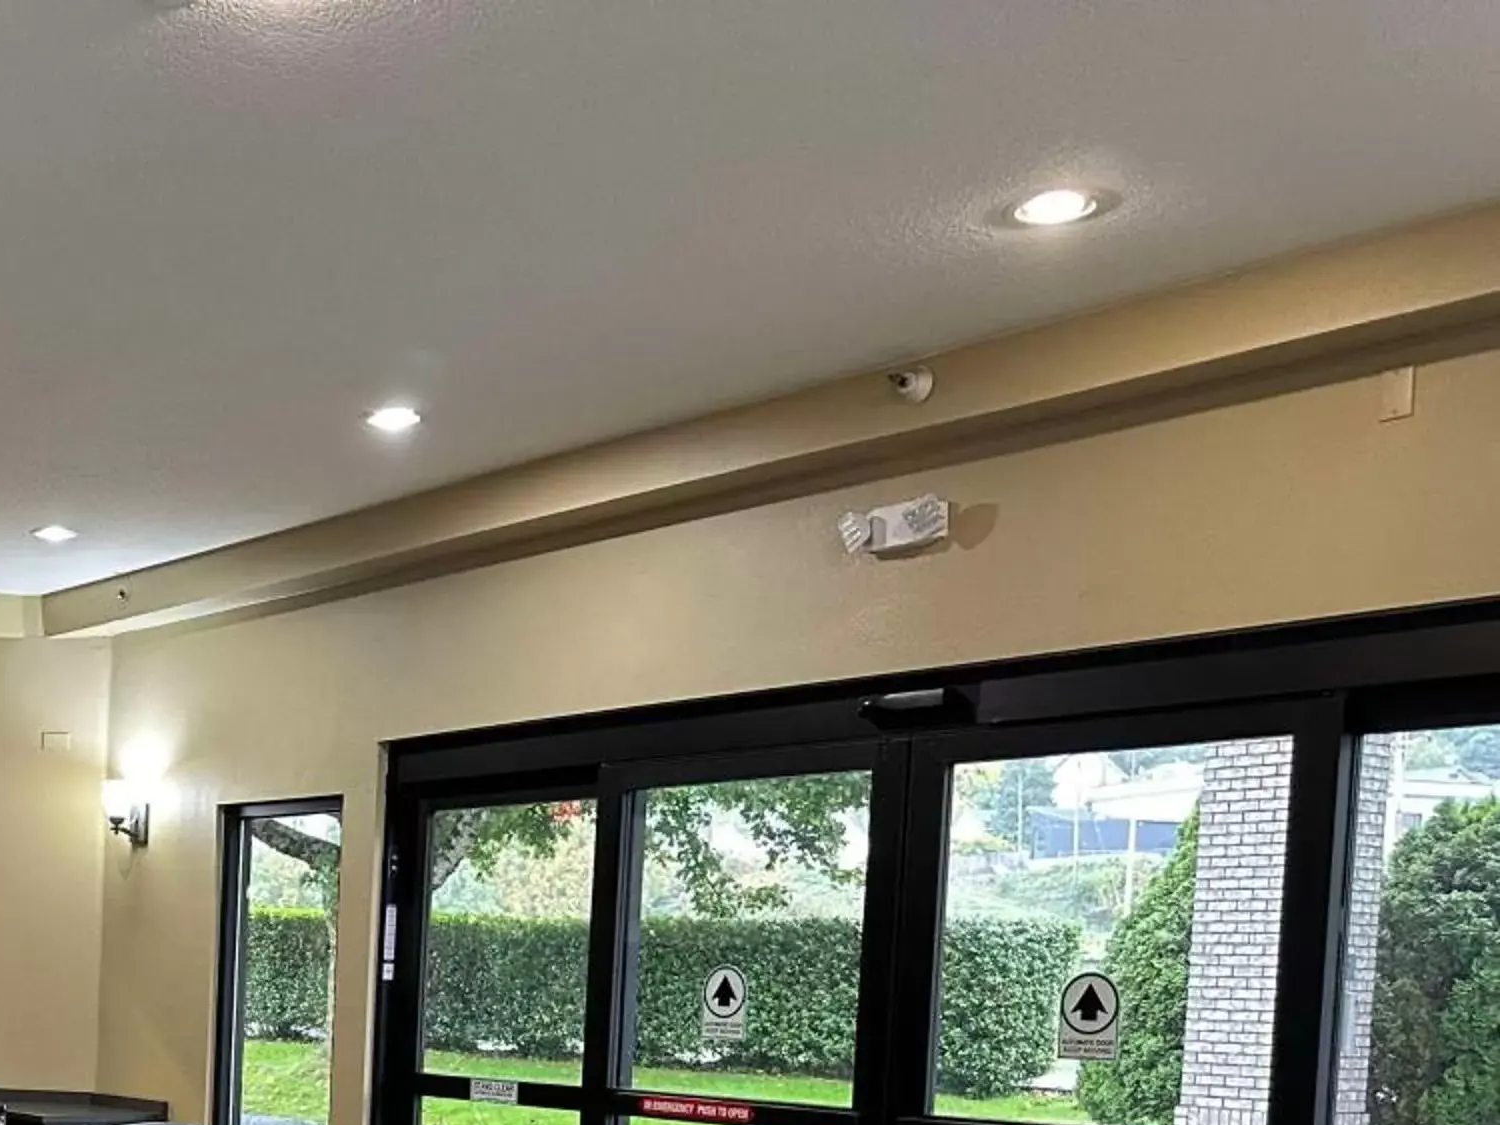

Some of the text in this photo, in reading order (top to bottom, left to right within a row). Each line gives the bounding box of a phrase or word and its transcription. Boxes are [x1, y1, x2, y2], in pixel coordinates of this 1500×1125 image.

[697, 1104, 717, 1117] PUSH
[718, 1106, 727, 1117] TO
[728, 1107, 749, 1120] OPEN
